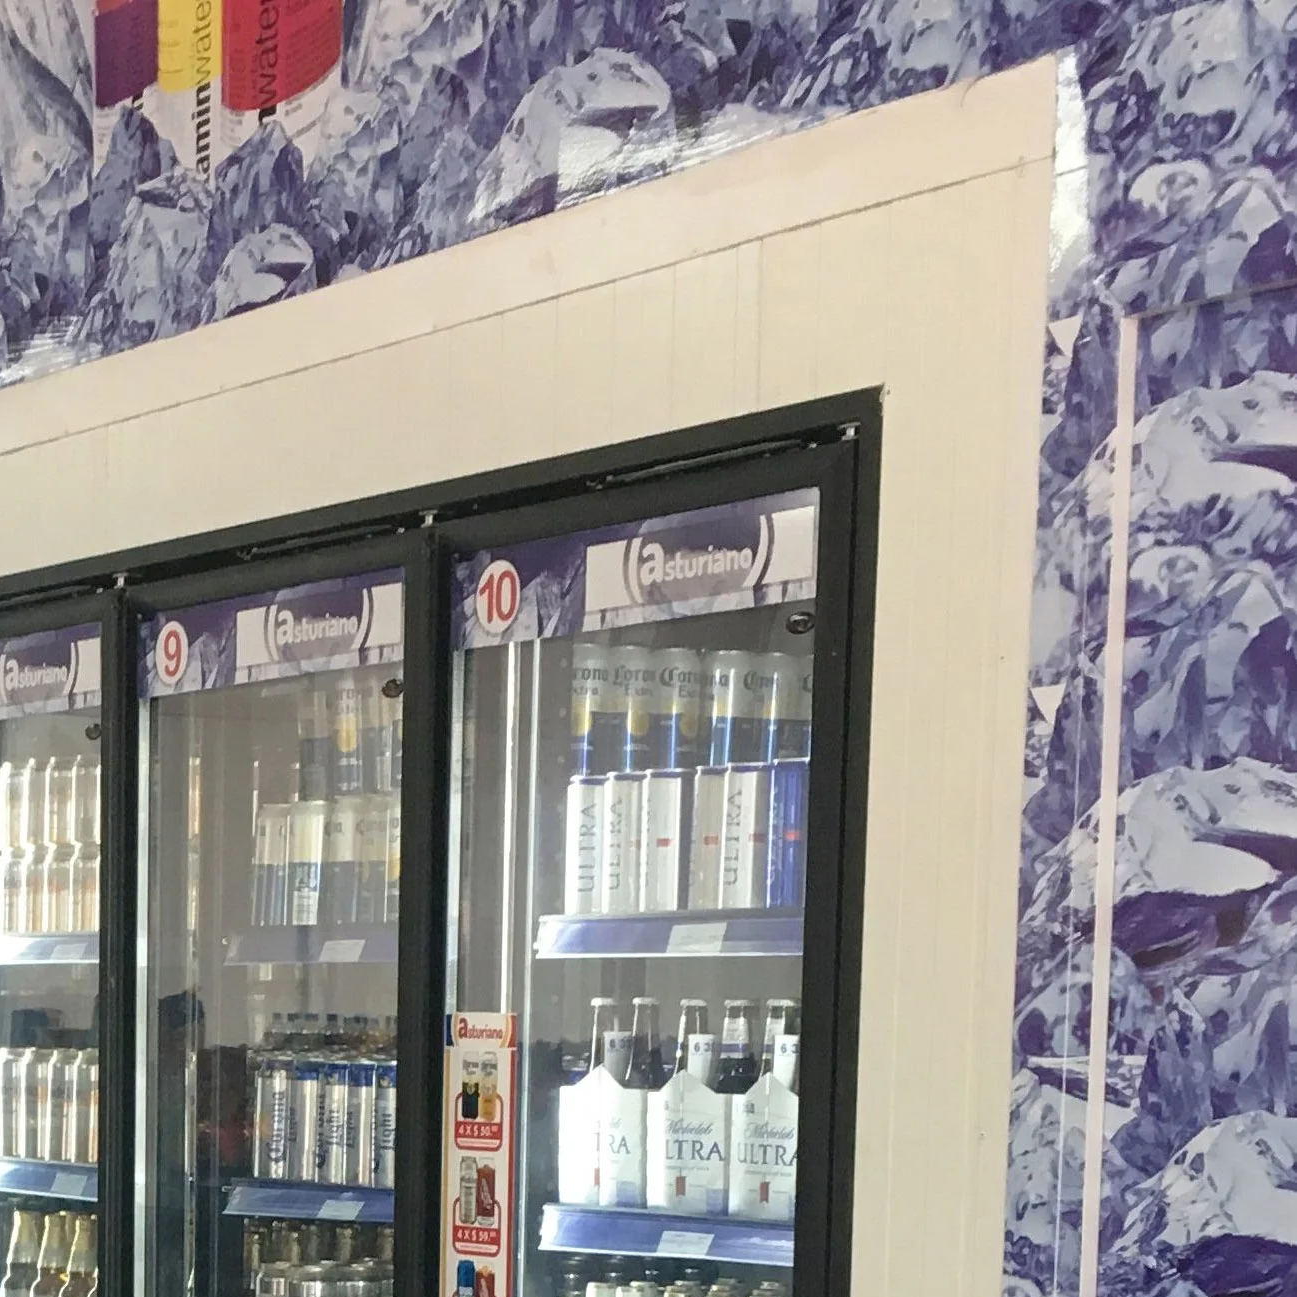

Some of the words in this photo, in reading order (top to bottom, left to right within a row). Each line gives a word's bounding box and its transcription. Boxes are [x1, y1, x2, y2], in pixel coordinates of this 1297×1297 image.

[640, 542, 752, 586] asturiano
[479, 570, 520, 625] 10
[277, 609, 359, 646] asturiano
[163, 629, 182, 677] 9
[578, 803, 597, 893] ULTRA
[458, 1016, 503, 1040] asturiano
[665, 1139, 725, 1162] LTRA
